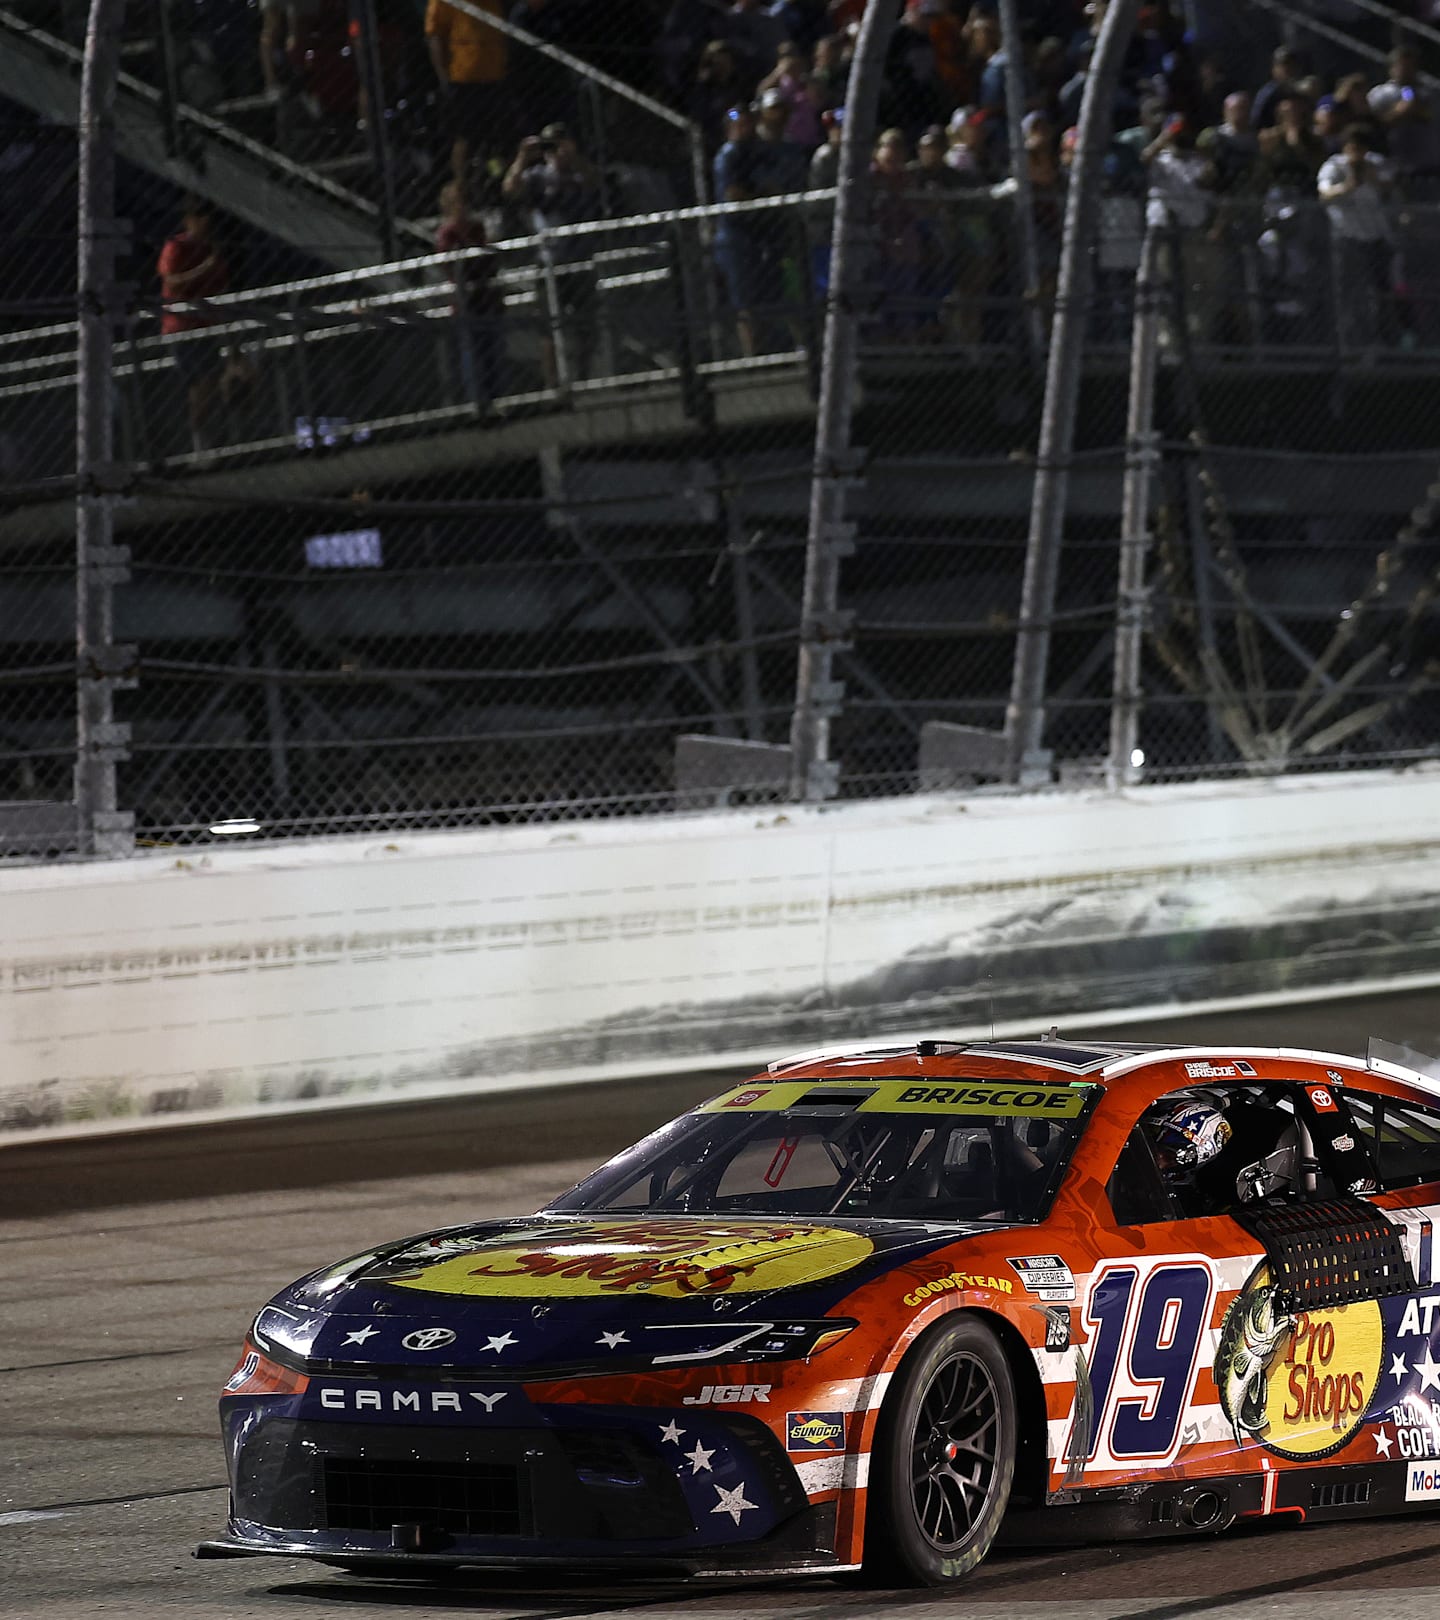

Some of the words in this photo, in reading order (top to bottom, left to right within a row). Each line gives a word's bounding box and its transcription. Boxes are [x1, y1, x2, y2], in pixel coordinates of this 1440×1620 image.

[1187, 1066, 1236, 1078] BRISCOE
[896, 1087, 1074, 1109] BRISCOE
[468, 1253, 756, 1293] Shops
[1028, 1258, 1058, 1268] NASCAR
[1027, 1273, 1041, 1283] CUP
[1042, 1271, 1066, 1282] SERIES
[903, 1272, 1012, 1307] GOODYEAR
[1285, 1312, 1335, 1366] Pro
[1065, 1266, 1211, 1460] 19
[321, 1388, 508, 1412] CAMRY
[683, 1384, 772, 1405] JGR
[1284, 1363, 1364, 1432] Shops
[791, 1425, 841, 1438] SUNOCO
